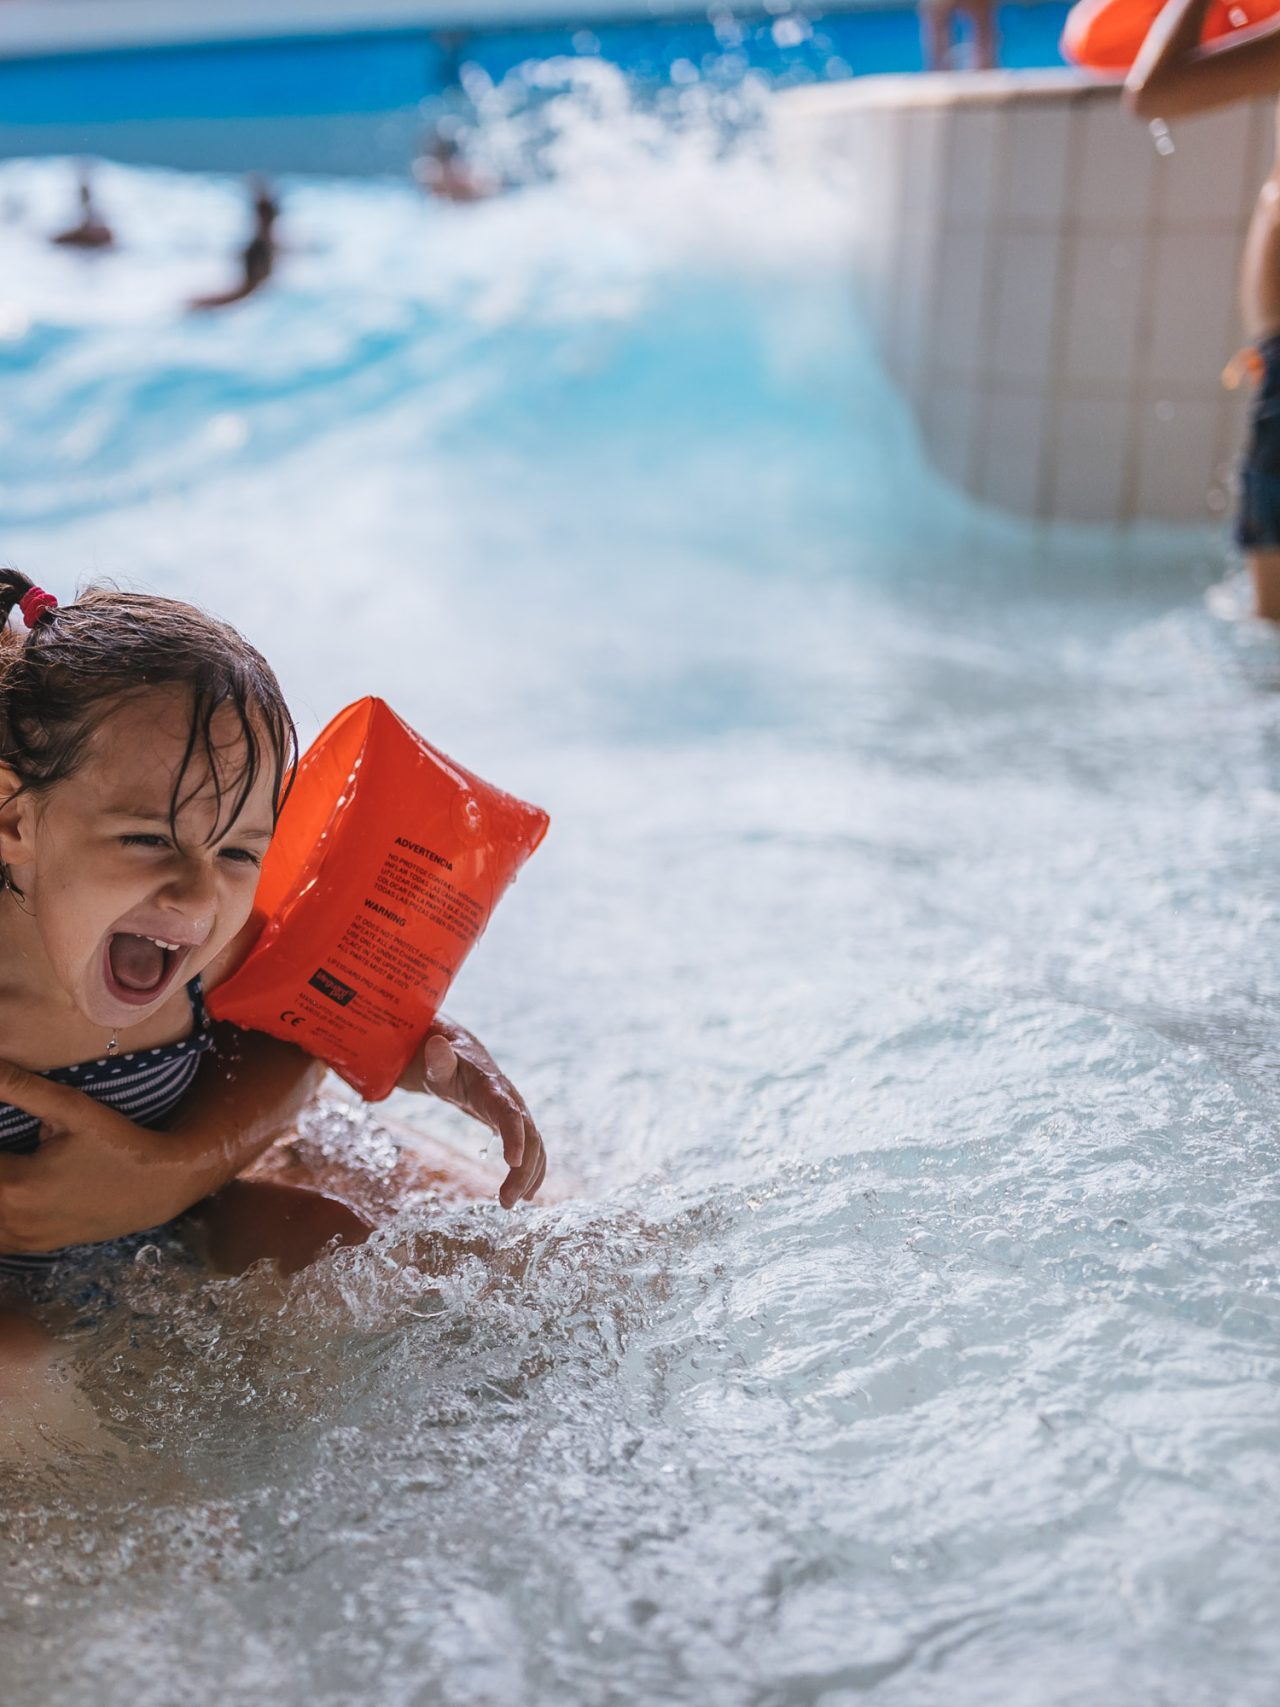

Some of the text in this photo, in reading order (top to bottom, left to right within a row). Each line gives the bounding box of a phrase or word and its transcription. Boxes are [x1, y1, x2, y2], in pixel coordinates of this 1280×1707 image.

[388, 853, 398, 861] NO
[394, 837, 453, 871] ADVERTENCIA
[374, 883, 394, 897] TODAS
[395, 895, 407, 904] LAS
[377, 875, 406, 893] COLOCAR
[409, 873, 428, 885] TODAS
[429, 884, 439, 892] LAS
[364, 899, 406, 926] WARNING
[346, 929, 357, 938] USE
[359, 937, 376, 949] ONLY
[377, 947, 396, 960] UNDER
[351, 922, 375, 938] INFLATE
[376, 937, 387, 946] ALL
[362, 919, 379, 931] DOES
[380, 929, 392, 939] NOT
[393, 937, 419, 954] PROTECT
[342, 936, 361, 949] PLACE
[371, 953, 381, 961] THE
[382, 960, 401, 973] UPPER
